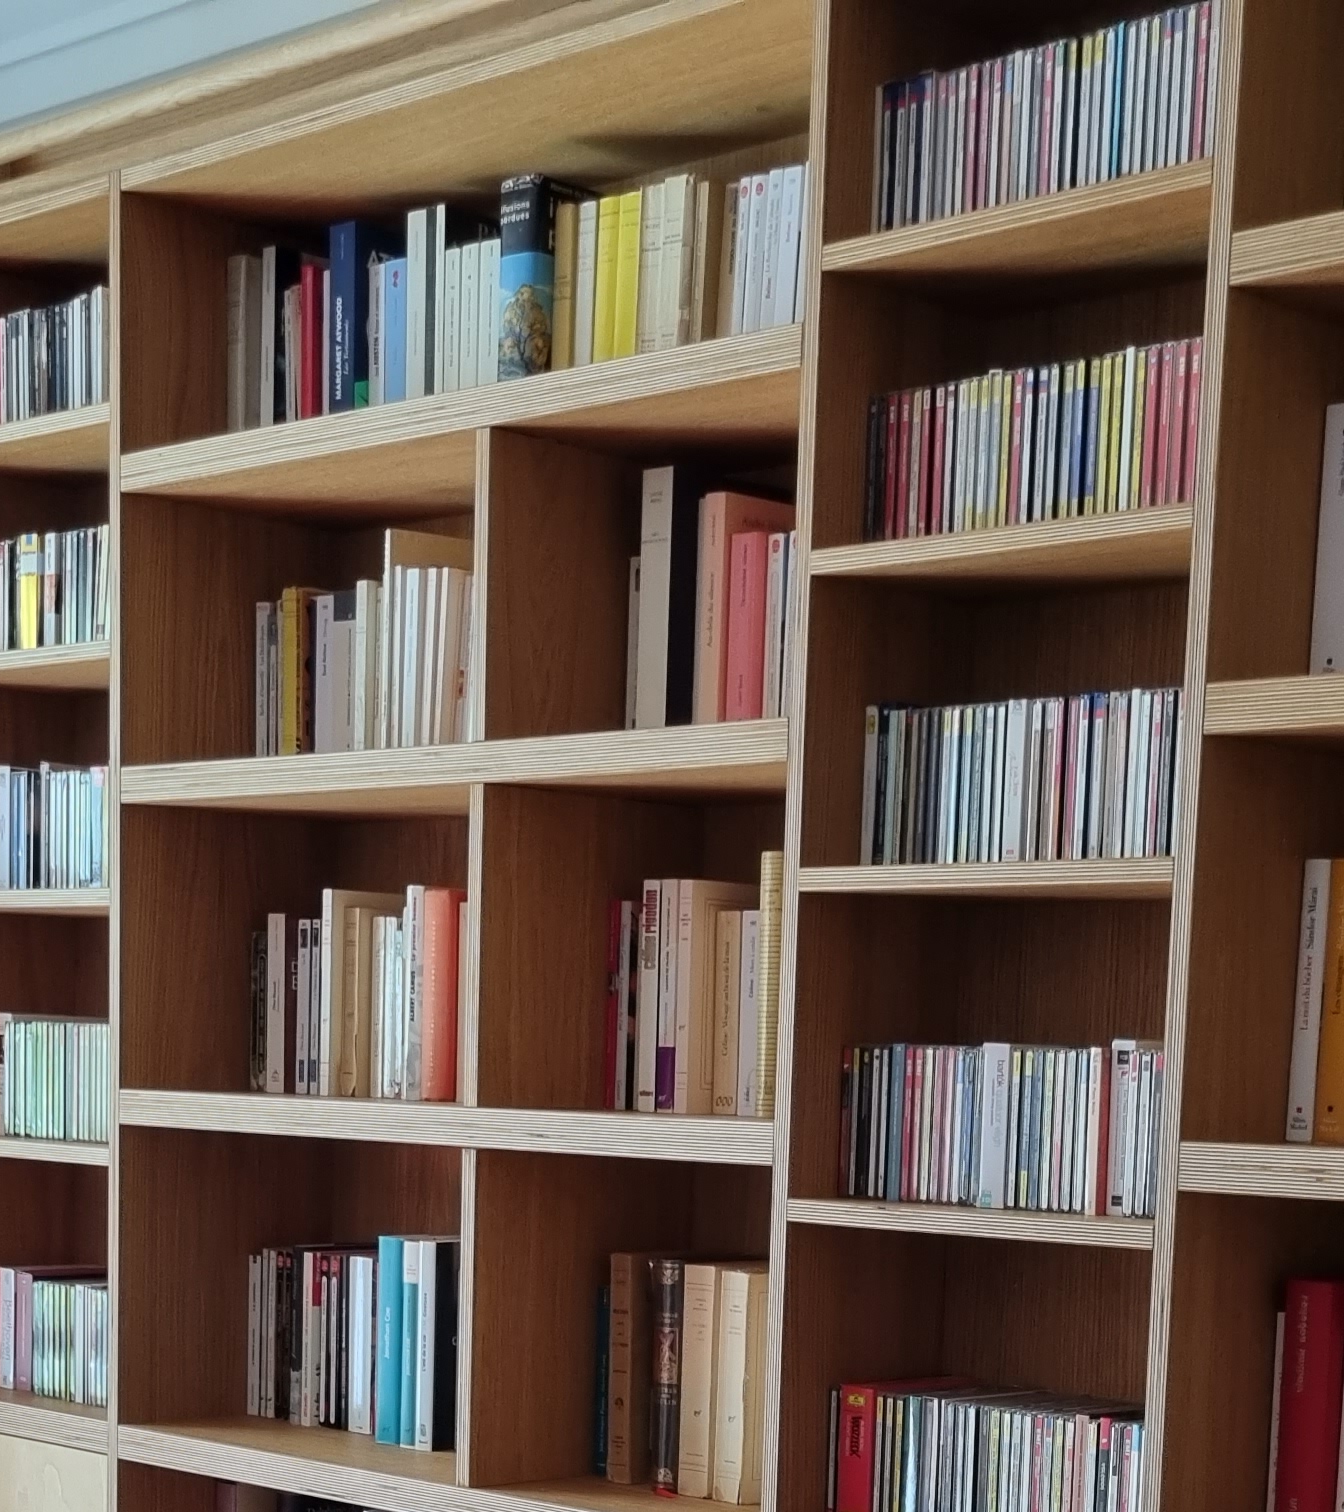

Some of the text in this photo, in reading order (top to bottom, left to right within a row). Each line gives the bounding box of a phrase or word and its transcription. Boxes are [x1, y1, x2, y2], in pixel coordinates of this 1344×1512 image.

[1300, 887, 1319, 1031] La nuit du bûcher Sándor Márai
[383, 1324, 391, 1359] Jonathan
